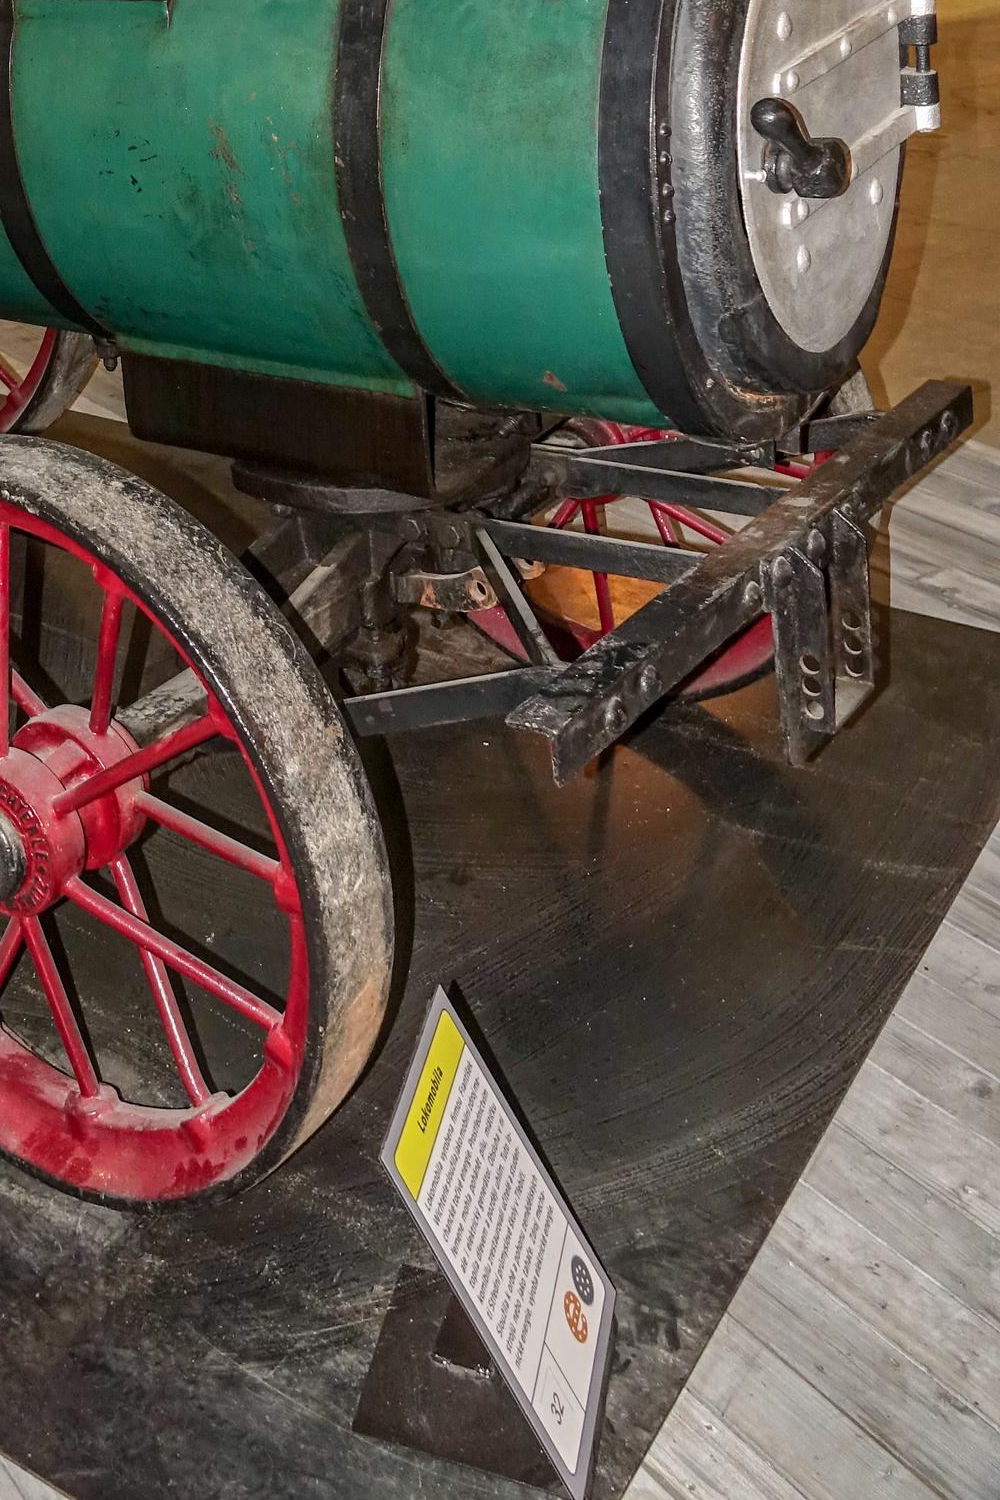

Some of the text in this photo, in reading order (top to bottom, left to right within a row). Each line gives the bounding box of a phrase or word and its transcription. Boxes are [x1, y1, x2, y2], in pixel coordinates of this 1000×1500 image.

[417, 1067, 443, 1133] Lokomobila
[423, 1059, 474, 1213] Lokomobila vyrobena firmou František
[432, 1183, 450, 1228] Wichterle
[445, 1152, 459, 1188] sloužila
[467, 1086, 478, 1113] zdroj
[550, 1391, 565, 1426] 32
